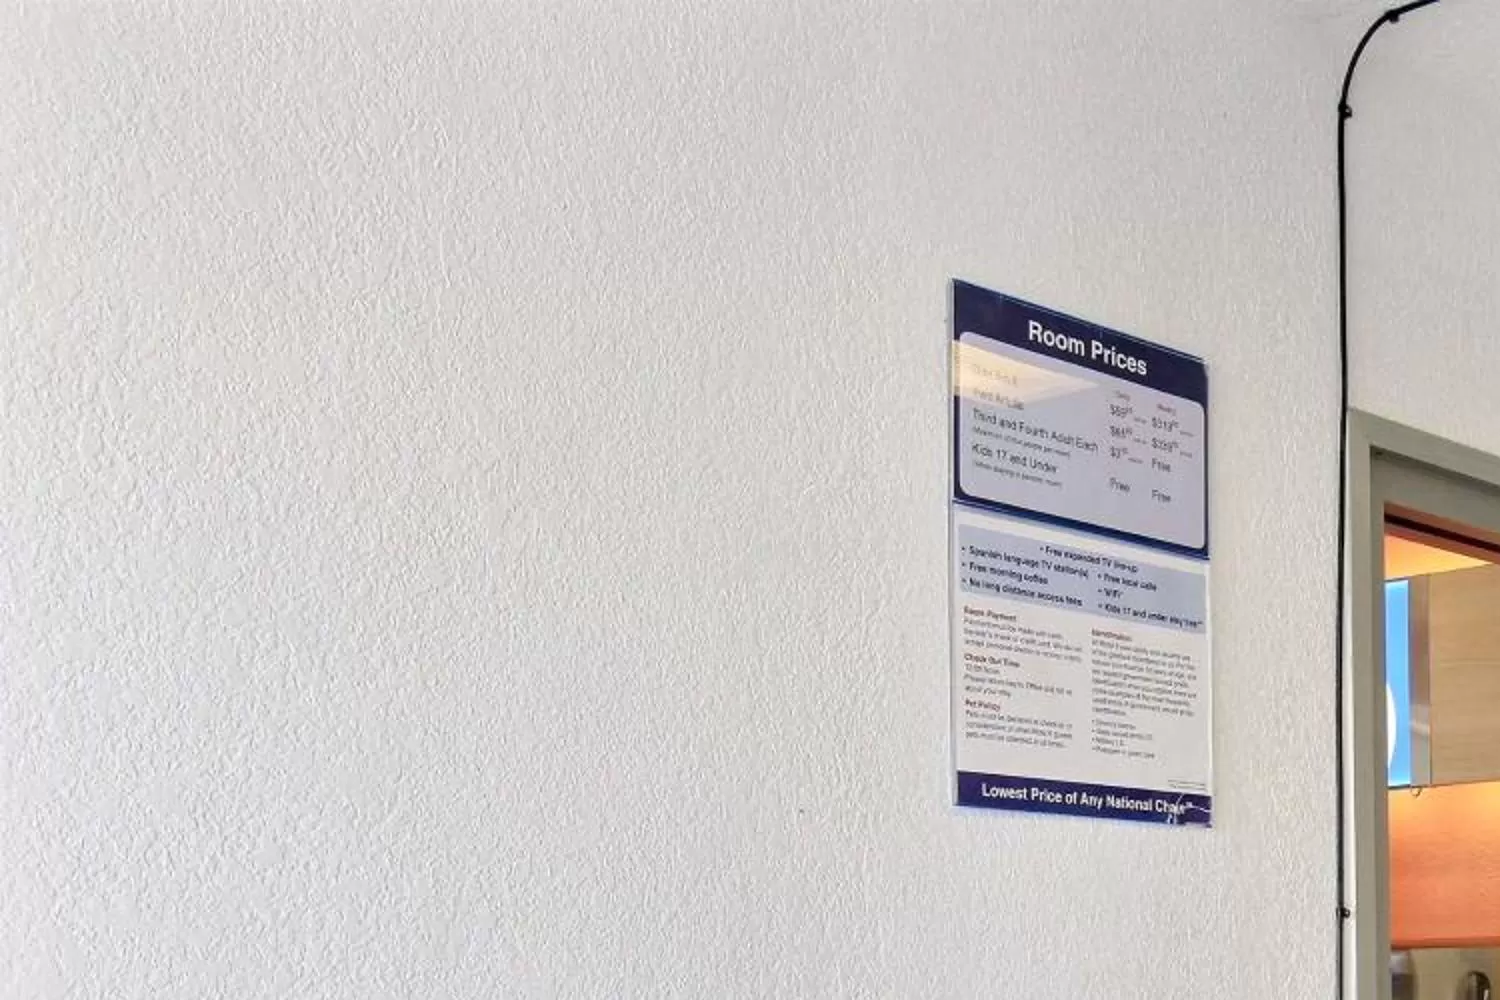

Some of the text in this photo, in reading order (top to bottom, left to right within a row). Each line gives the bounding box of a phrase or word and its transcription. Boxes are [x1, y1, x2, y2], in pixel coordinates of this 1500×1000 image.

[1028, 320, 1148, 377] Room Prices
[973, 407, 997, 425] Third
[999, 417, 1017, 431] and
[1019, 421, 1049, 440] Fourth
[972, 443, 993, 458] Kids
[996, 449, 1007, 460] 17
[1009, 454, 1027, 467] and
[1029, 456, 1057, 473] Under
[969, 561, 988, 574] Free
[981, 782, 1029, 800] Lowest
[1031, 787, 1063, 804] Price
[1066, 791, 1078, 805] of
[1080, 793, 1103, 809] Any
[1106, 795, 1153, 812] National
